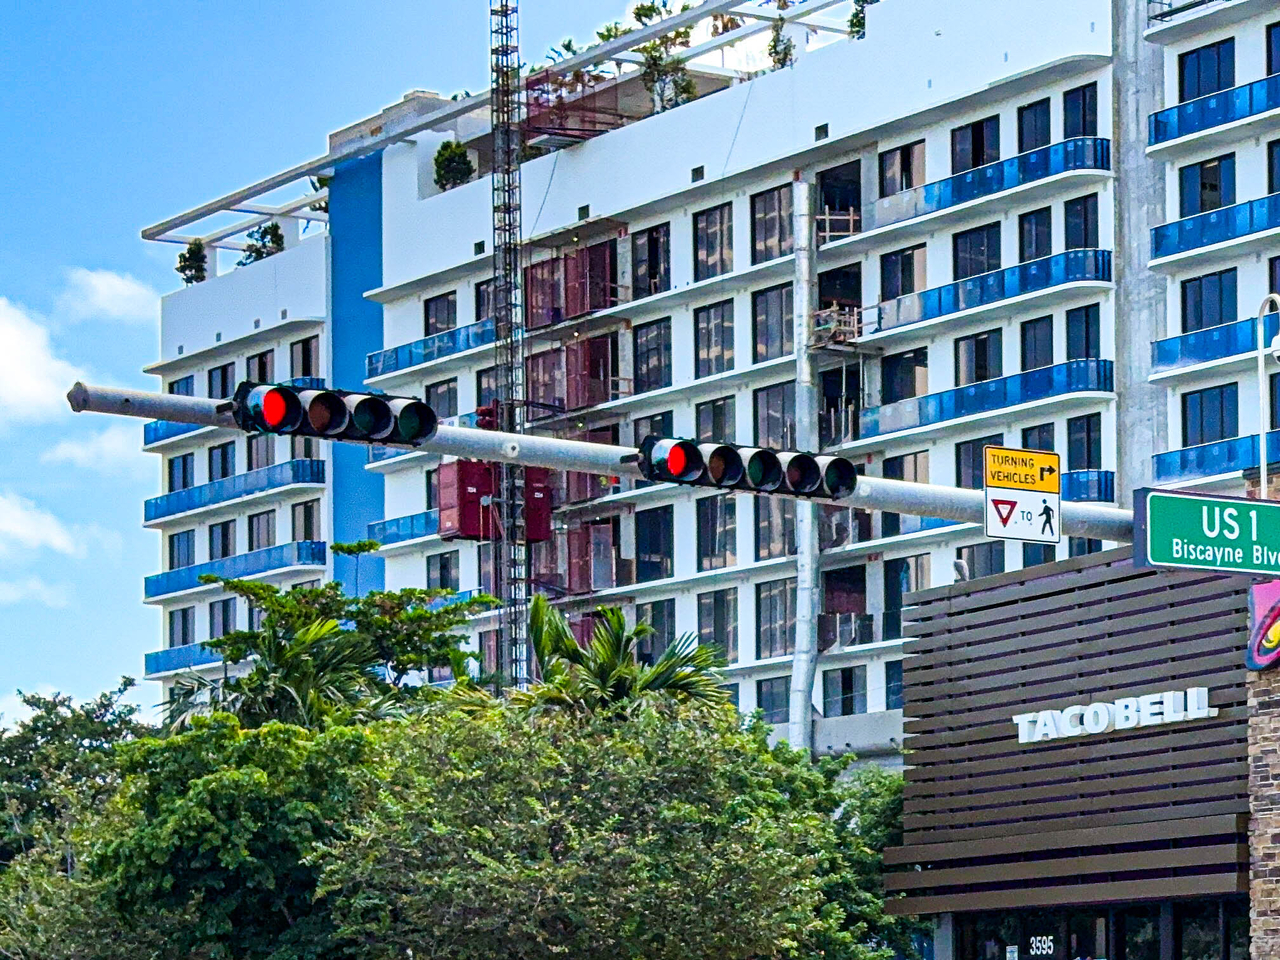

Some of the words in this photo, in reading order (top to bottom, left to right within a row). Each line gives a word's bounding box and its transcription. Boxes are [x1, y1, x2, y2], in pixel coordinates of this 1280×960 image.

[991, 454, 1034, 469] TURNING
[990, 470, 1036, 485] VEHICLES
[1020, 510, 1033, 522] TO
[1202, 505, 1240, 540] US
[1249, 510, 1257, 541] 1
[1172, 538, 1243, 566] Biscayne
[1012, 702, 1114, 744] TACO
[1114, 686, 1219, 730] BELL
[1029, 935, 1054, 956] 3595
